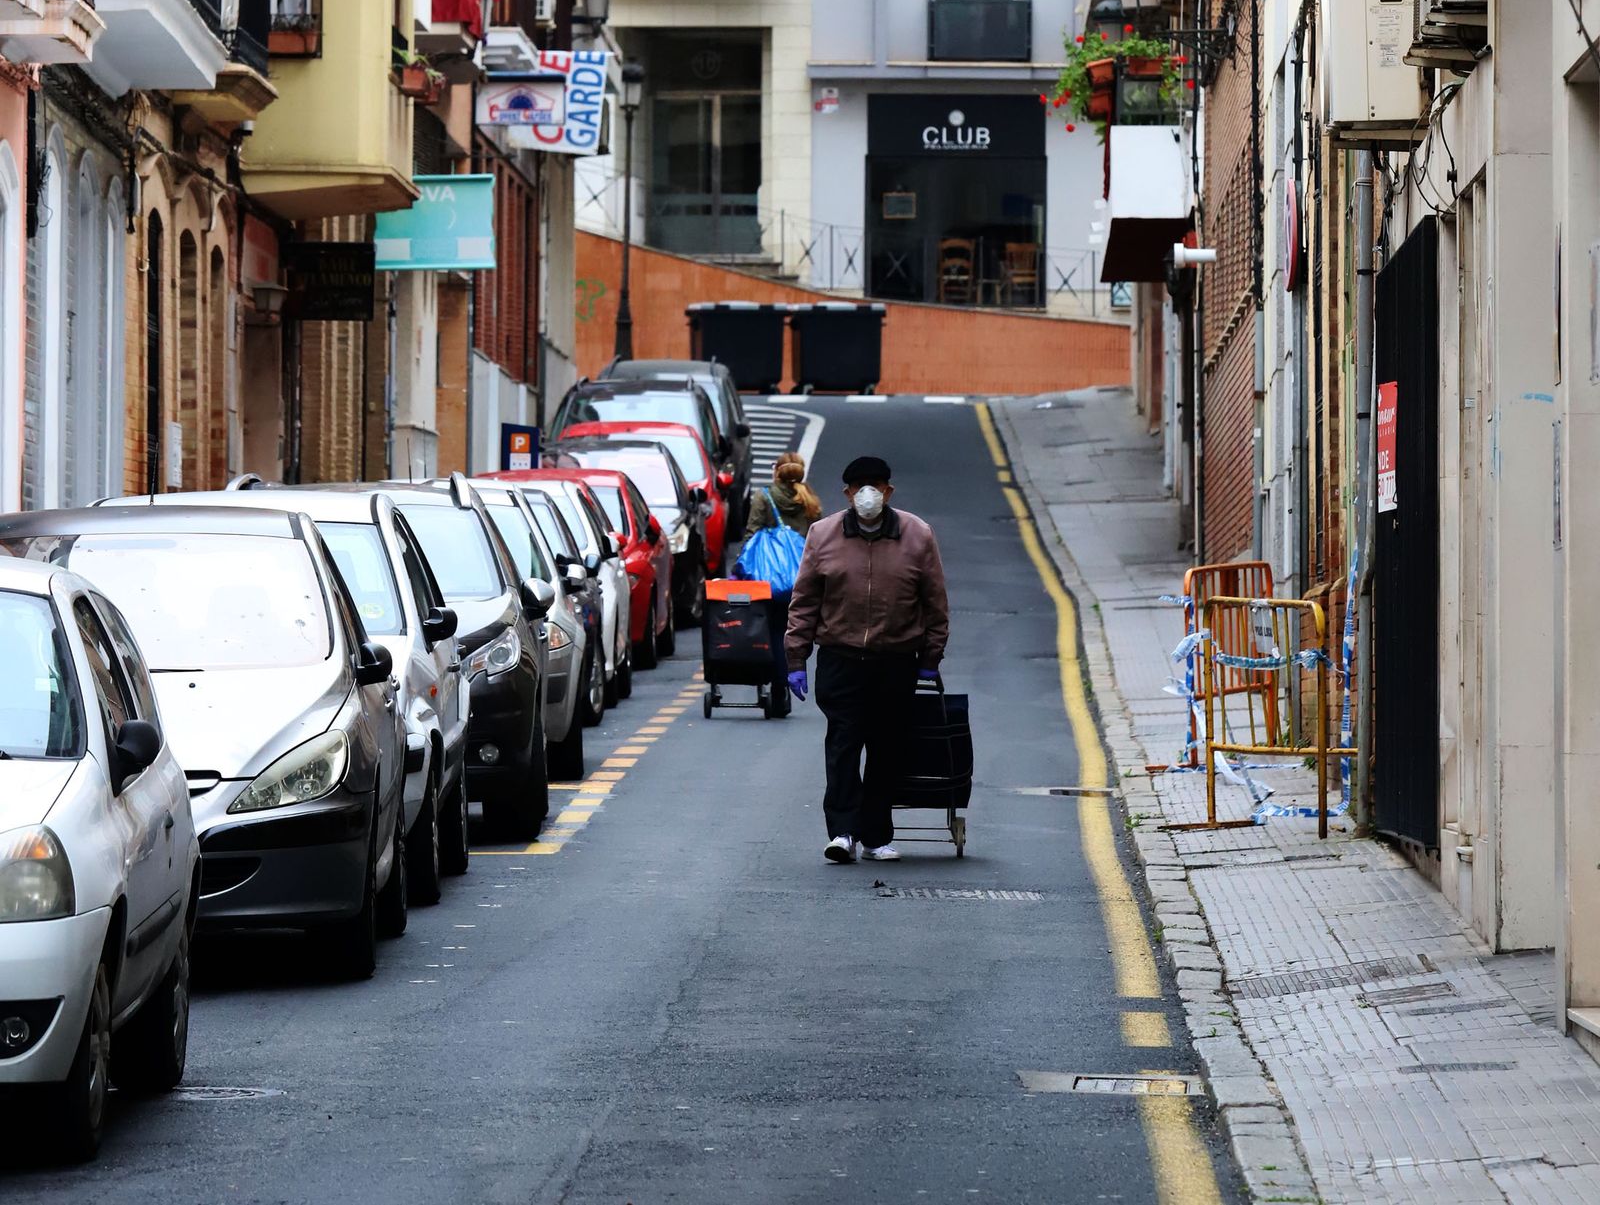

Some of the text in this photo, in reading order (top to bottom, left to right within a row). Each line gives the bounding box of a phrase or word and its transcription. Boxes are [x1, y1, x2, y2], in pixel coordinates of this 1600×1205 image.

[922, 126, 991, 145] CLUB
[420, 185, 456, 202] VA
[514, 436, 526, 450] P
[1378, 449, 1390, 470] NDE
